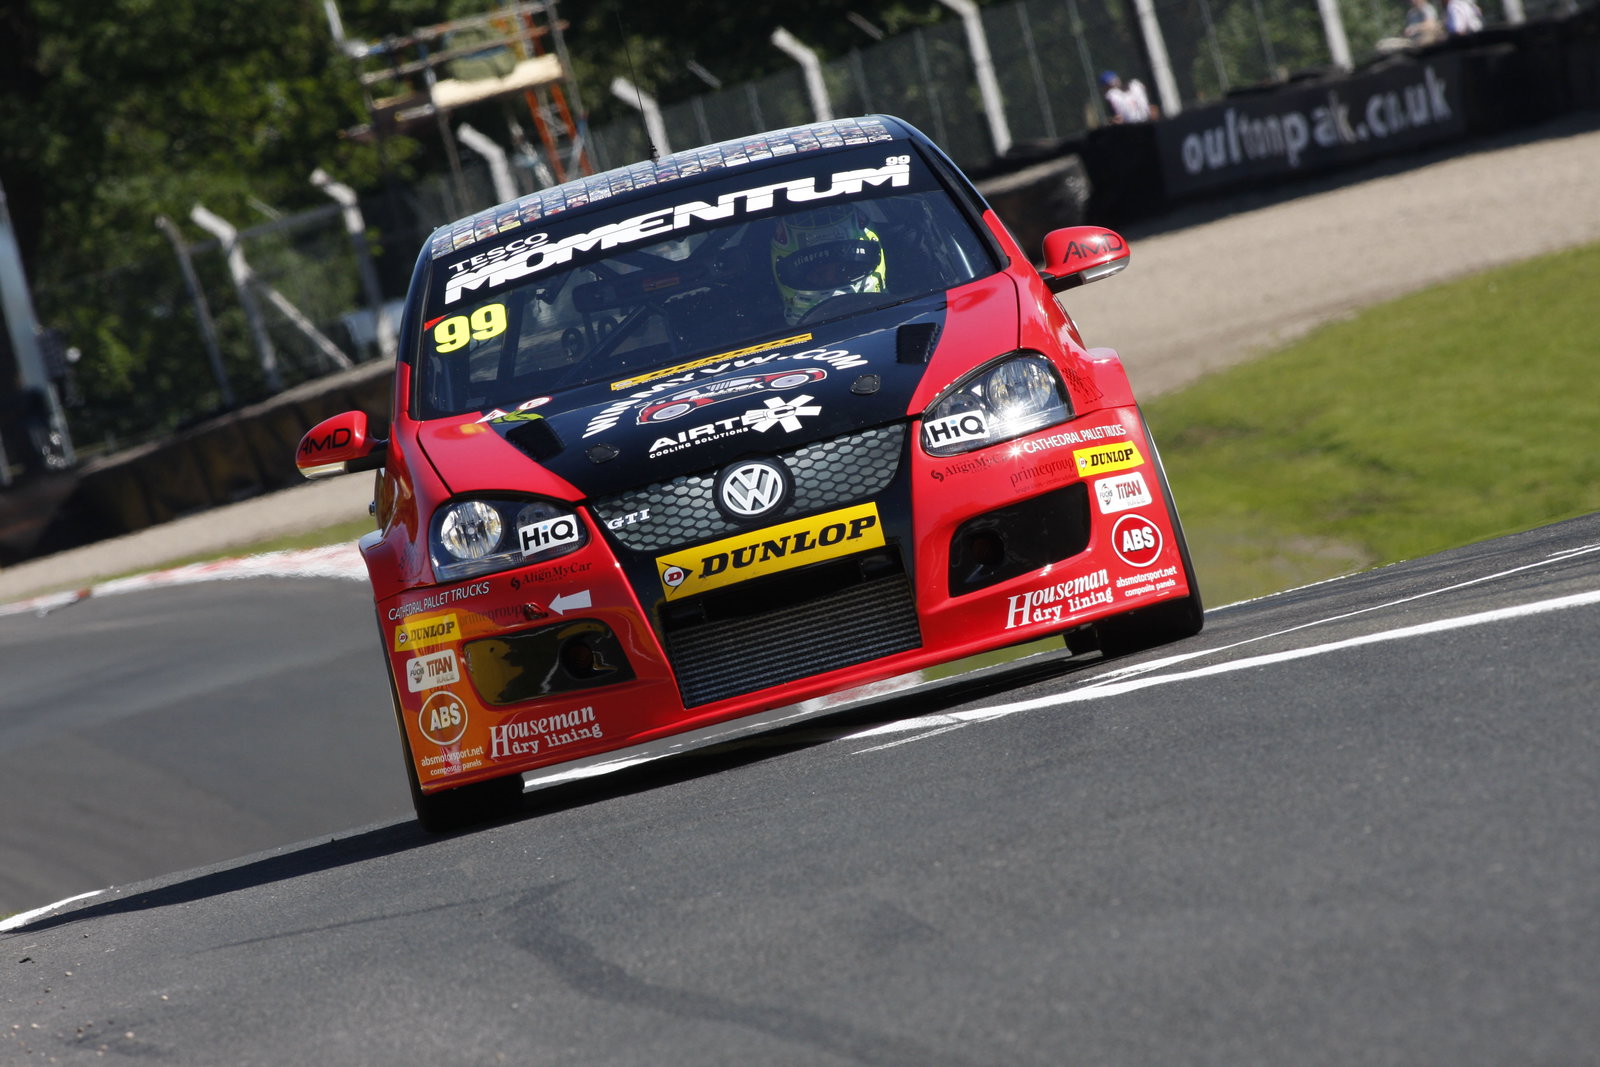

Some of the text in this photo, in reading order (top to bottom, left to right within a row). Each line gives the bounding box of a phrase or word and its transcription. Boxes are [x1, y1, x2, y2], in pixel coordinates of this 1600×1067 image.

[444, 164, 910, 305] MOMENTUM
[1062, 233, 1123, 264] AMD
[448, 232, 549, 272] TESCO
[433, 303, 507, 353] 99
[301, 428, 351, 455] AMD
[649, 404, 797, 453] AIRTEC
[649, 426, 749, 459] COOLING SOLUTIONS
[929, 415, 986, 443] HiQ
[1023, 431, 1083, 455] CATHEDRAL
[1081, 426, 1105, 442] PALLET
[1090, 448, 1134, 467] DUNLOP
[607, 508, 650, 530] GTI
[522, 520, 575, 552] HiQ
[698, 515, 877, 579] DUNLOP
[1122, 526, 1155, 553] ABS
[522, 562, 593, 584] AlignMyCar
[1116, 565, 1178, 588] absmotorsport.net
[388, 581, 490, 621] CATHEDRAL PALLET TRUCKS
[1124, 578, 1176, 598] composite panels
[1033, 587, 1114, 623] dry lining
[410, 621, 455, 641] DUNLOP
[429, 702, 461, 732] ABS
[512, 722, 603, 755] dry lining
[421, 745, 484, 767] absmotorsport.net
[462, 759, 483, 771] panels
